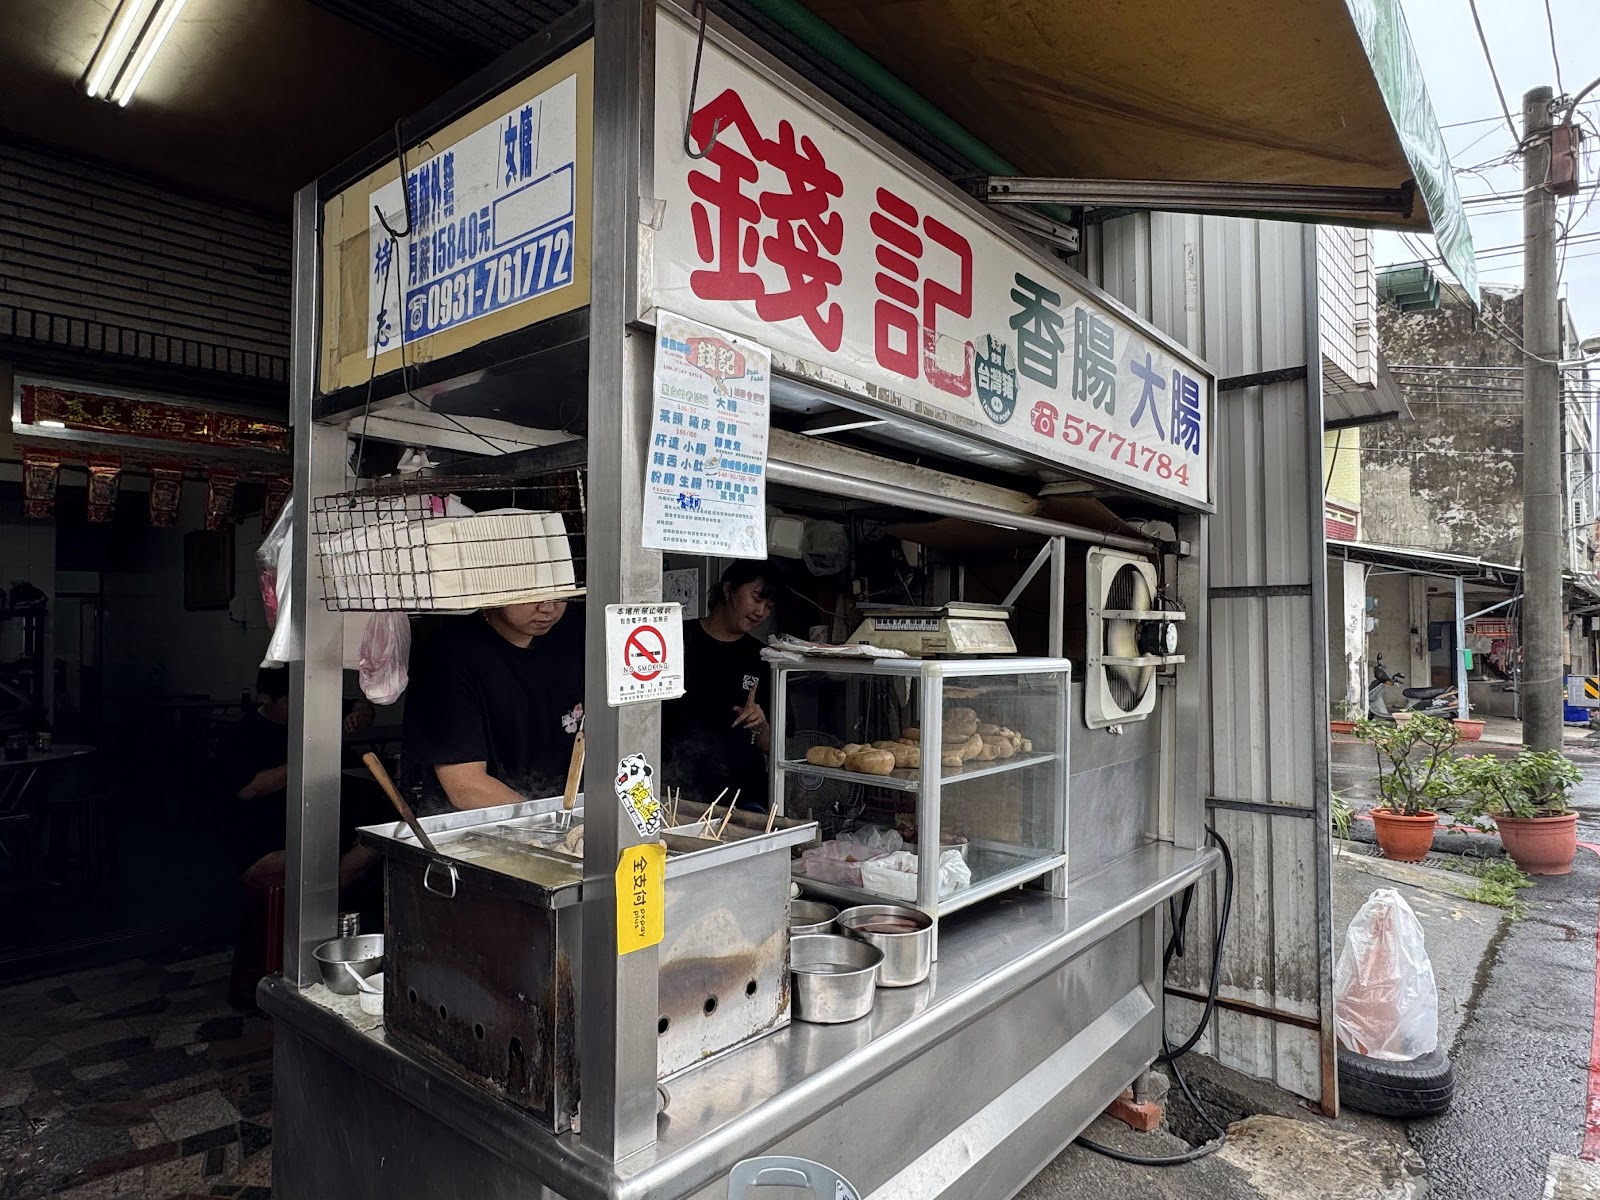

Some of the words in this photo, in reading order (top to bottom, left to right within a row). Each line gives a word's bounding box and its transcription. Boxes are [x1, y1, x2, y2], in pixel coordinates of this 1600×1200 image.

[687, 88, 973, 398] 錢記
[426, 229, 570, 330] 0931-761772
[697, 341, 736, 375] 錢記
[978, 362, 1014, 400] 台灣豬
[1009, 272, 1118, 416] 香腸
[1129, 351, 1201, 456] 大腸
[1062, 412, 1190, 487] 5771784
[623, 666, 634, 674] NO
[637, 662, 668, 673] SMOKING
[633, 855, 648, 906] 全支付
